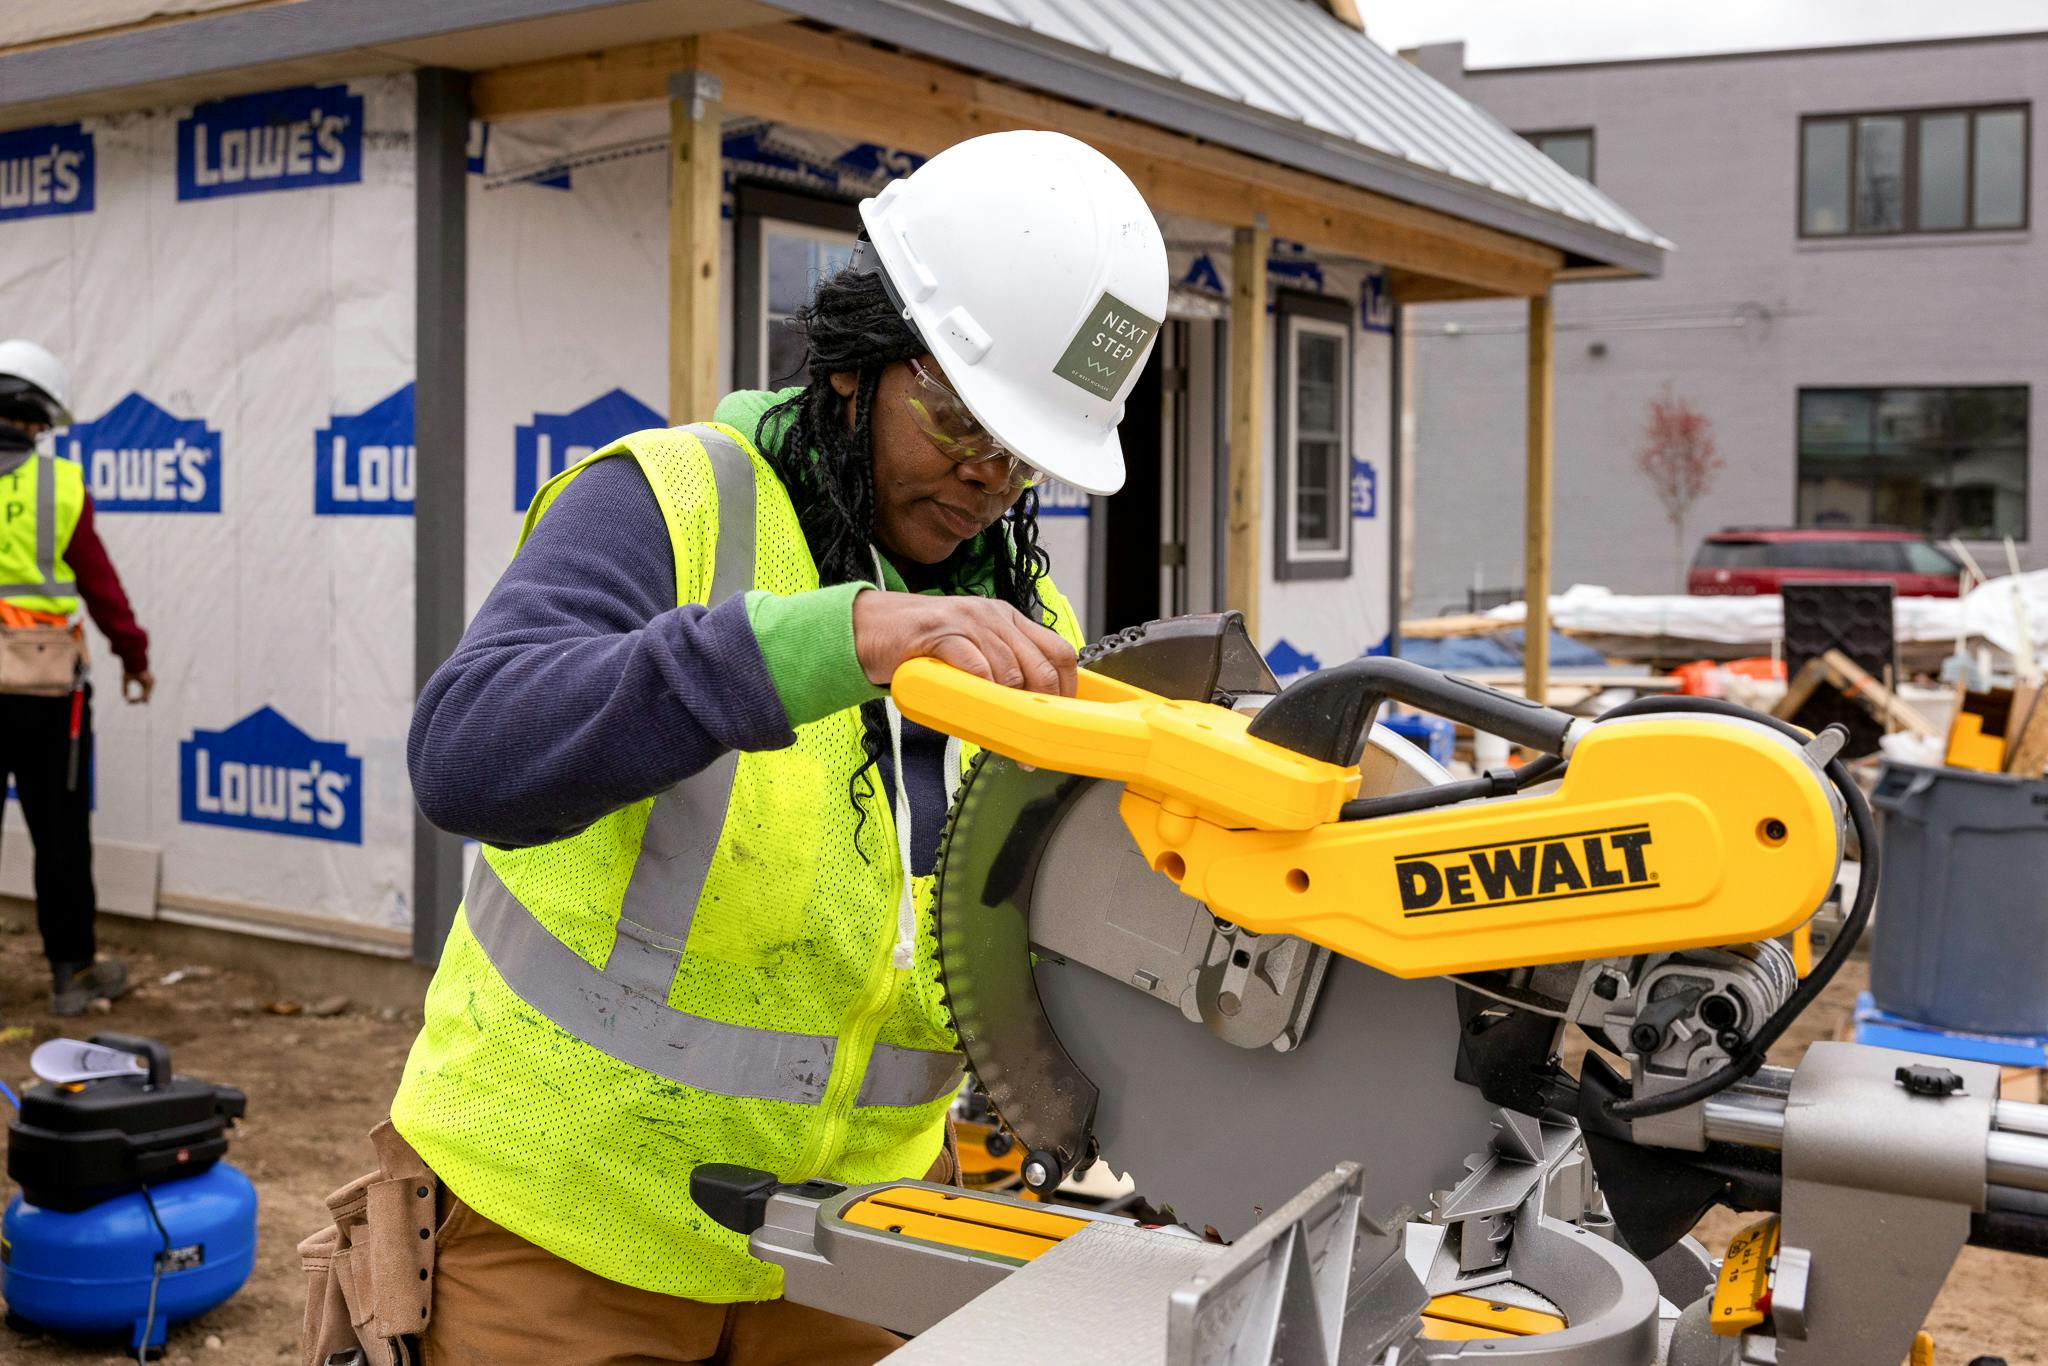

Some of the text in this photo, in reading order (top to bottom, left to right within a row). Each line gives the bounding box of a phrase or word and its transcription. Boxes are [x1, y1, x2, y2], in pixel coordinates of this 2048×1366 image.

[194, 108, 346, 187] LOWE'S
[0, 143, 80, 210] WE'S
[1092, 332, 1134, 361] STEP
[1102, 311, 1148, 344] NEXT
[332, 434, 416, 502] LOW
[196, 748, 346, 830] LOWE'S
[1729, 1268, 1739, 1282] 15
[1724, 1307, 1732, 1316] 0
